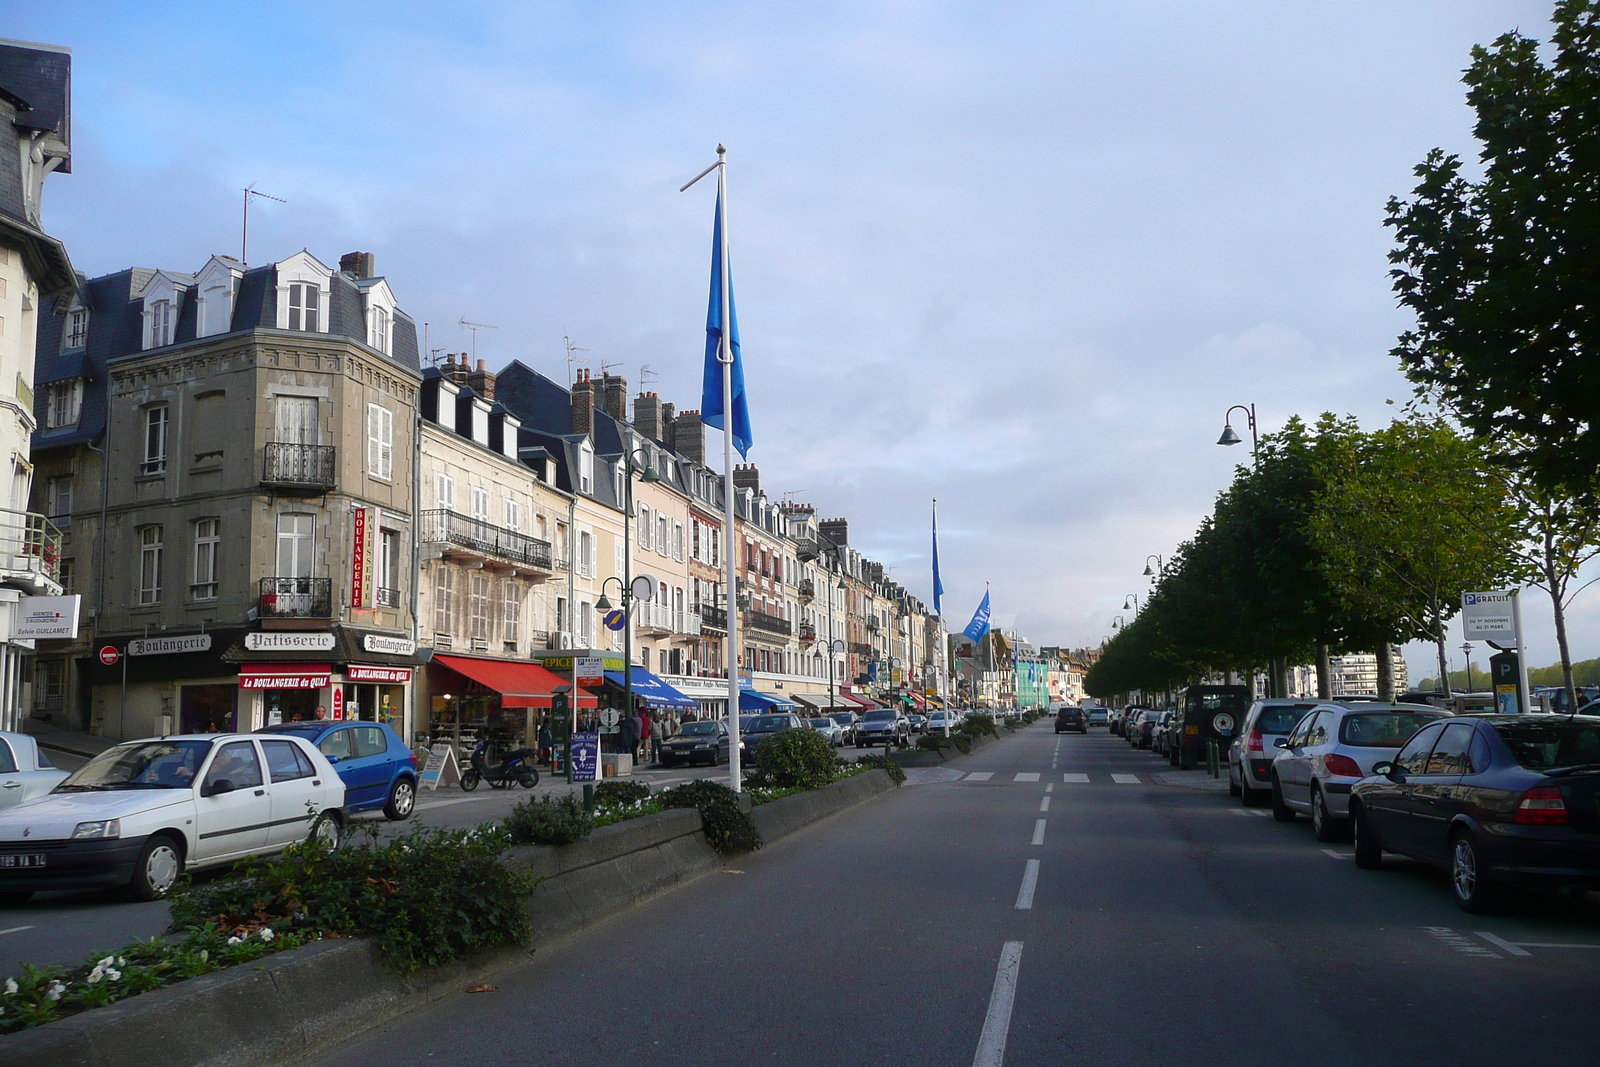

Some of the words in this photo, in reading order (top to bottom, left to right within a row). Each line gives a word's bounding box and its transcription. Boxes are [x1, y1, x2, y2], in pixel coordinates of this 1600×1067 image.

[353, 510, 363, 606] BOULANGERIE
[365, 515, 373, 600] PATISSERIE
[1476, 595, 1509, 603] GRATUIT
[18, 628, 35, 636] Sylvie
[36, 627, 70, 635] GUILLAMET
[134, 636, 206, 654] Boulangerie
[252, 634, 329, 649] Patisserie
[368, 636, 413, 653] Boulangerie
[545, 657, 574, 668] EPICE
[350, 668, 357, 678] La
[357, 669, 390, 679] BOULANGERIE
[390, 671, 396, 679] du
[396, 671, 408, 682] QUAI
[244, 678, 253, 688] La
[253, 677, 299, 688] BOULANGERIE
[300, 678, 309, 687] du
[310, 677, 327, 689] QUAI
[665, 678, 680, 686] Grande
[682, 678, 702, 687] Pharmacie
